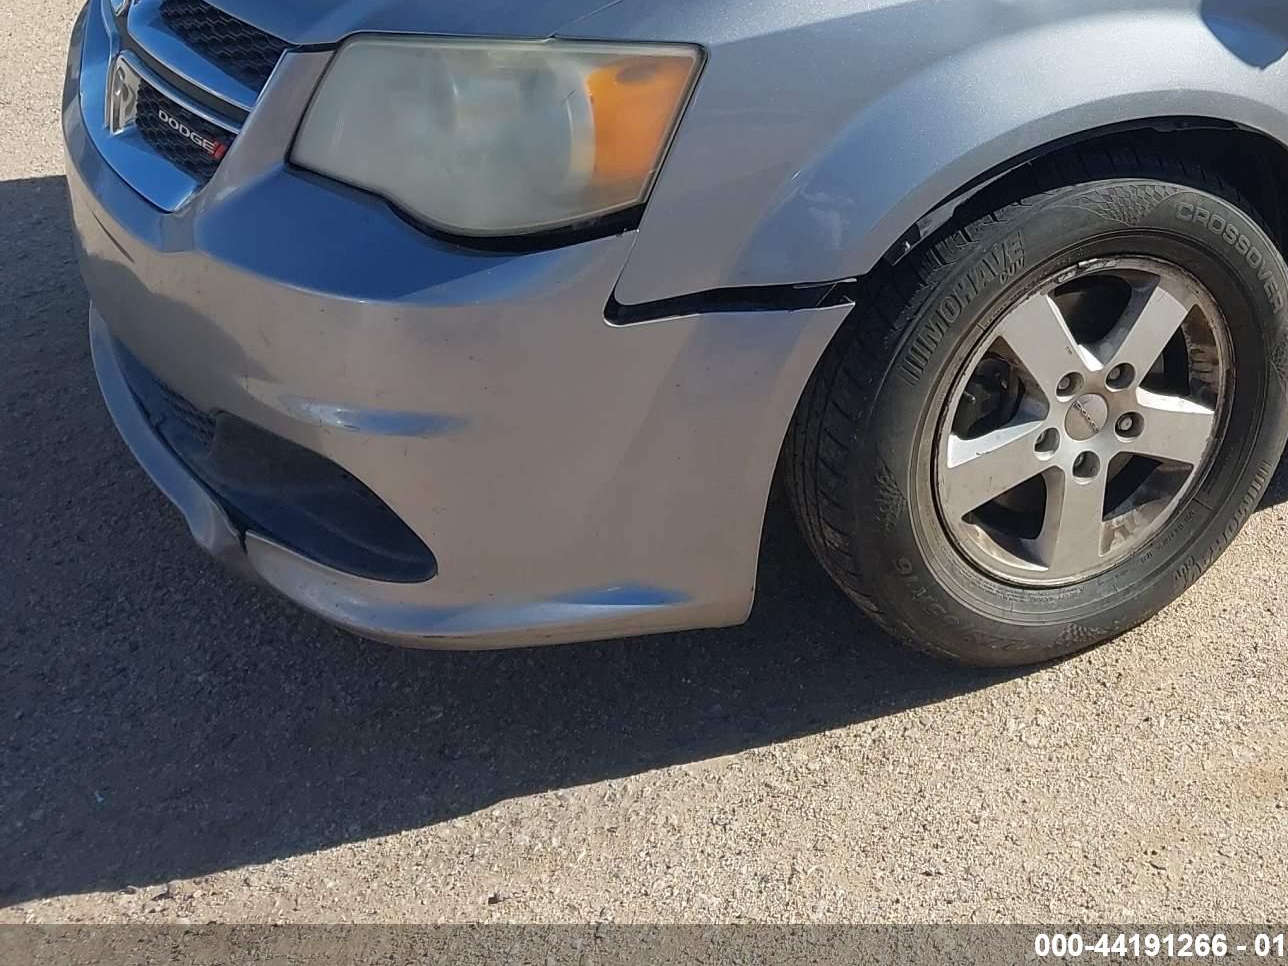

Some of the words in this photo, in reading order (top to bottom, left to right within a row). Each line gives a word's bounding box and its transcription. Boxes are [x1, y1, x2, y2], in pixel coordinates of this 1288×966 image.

[159, 109, 215, 154] DODGE
[916, 230, 1025, 356] MOHAVE
[1176, 201, 1283, 314] CROSSOVER
